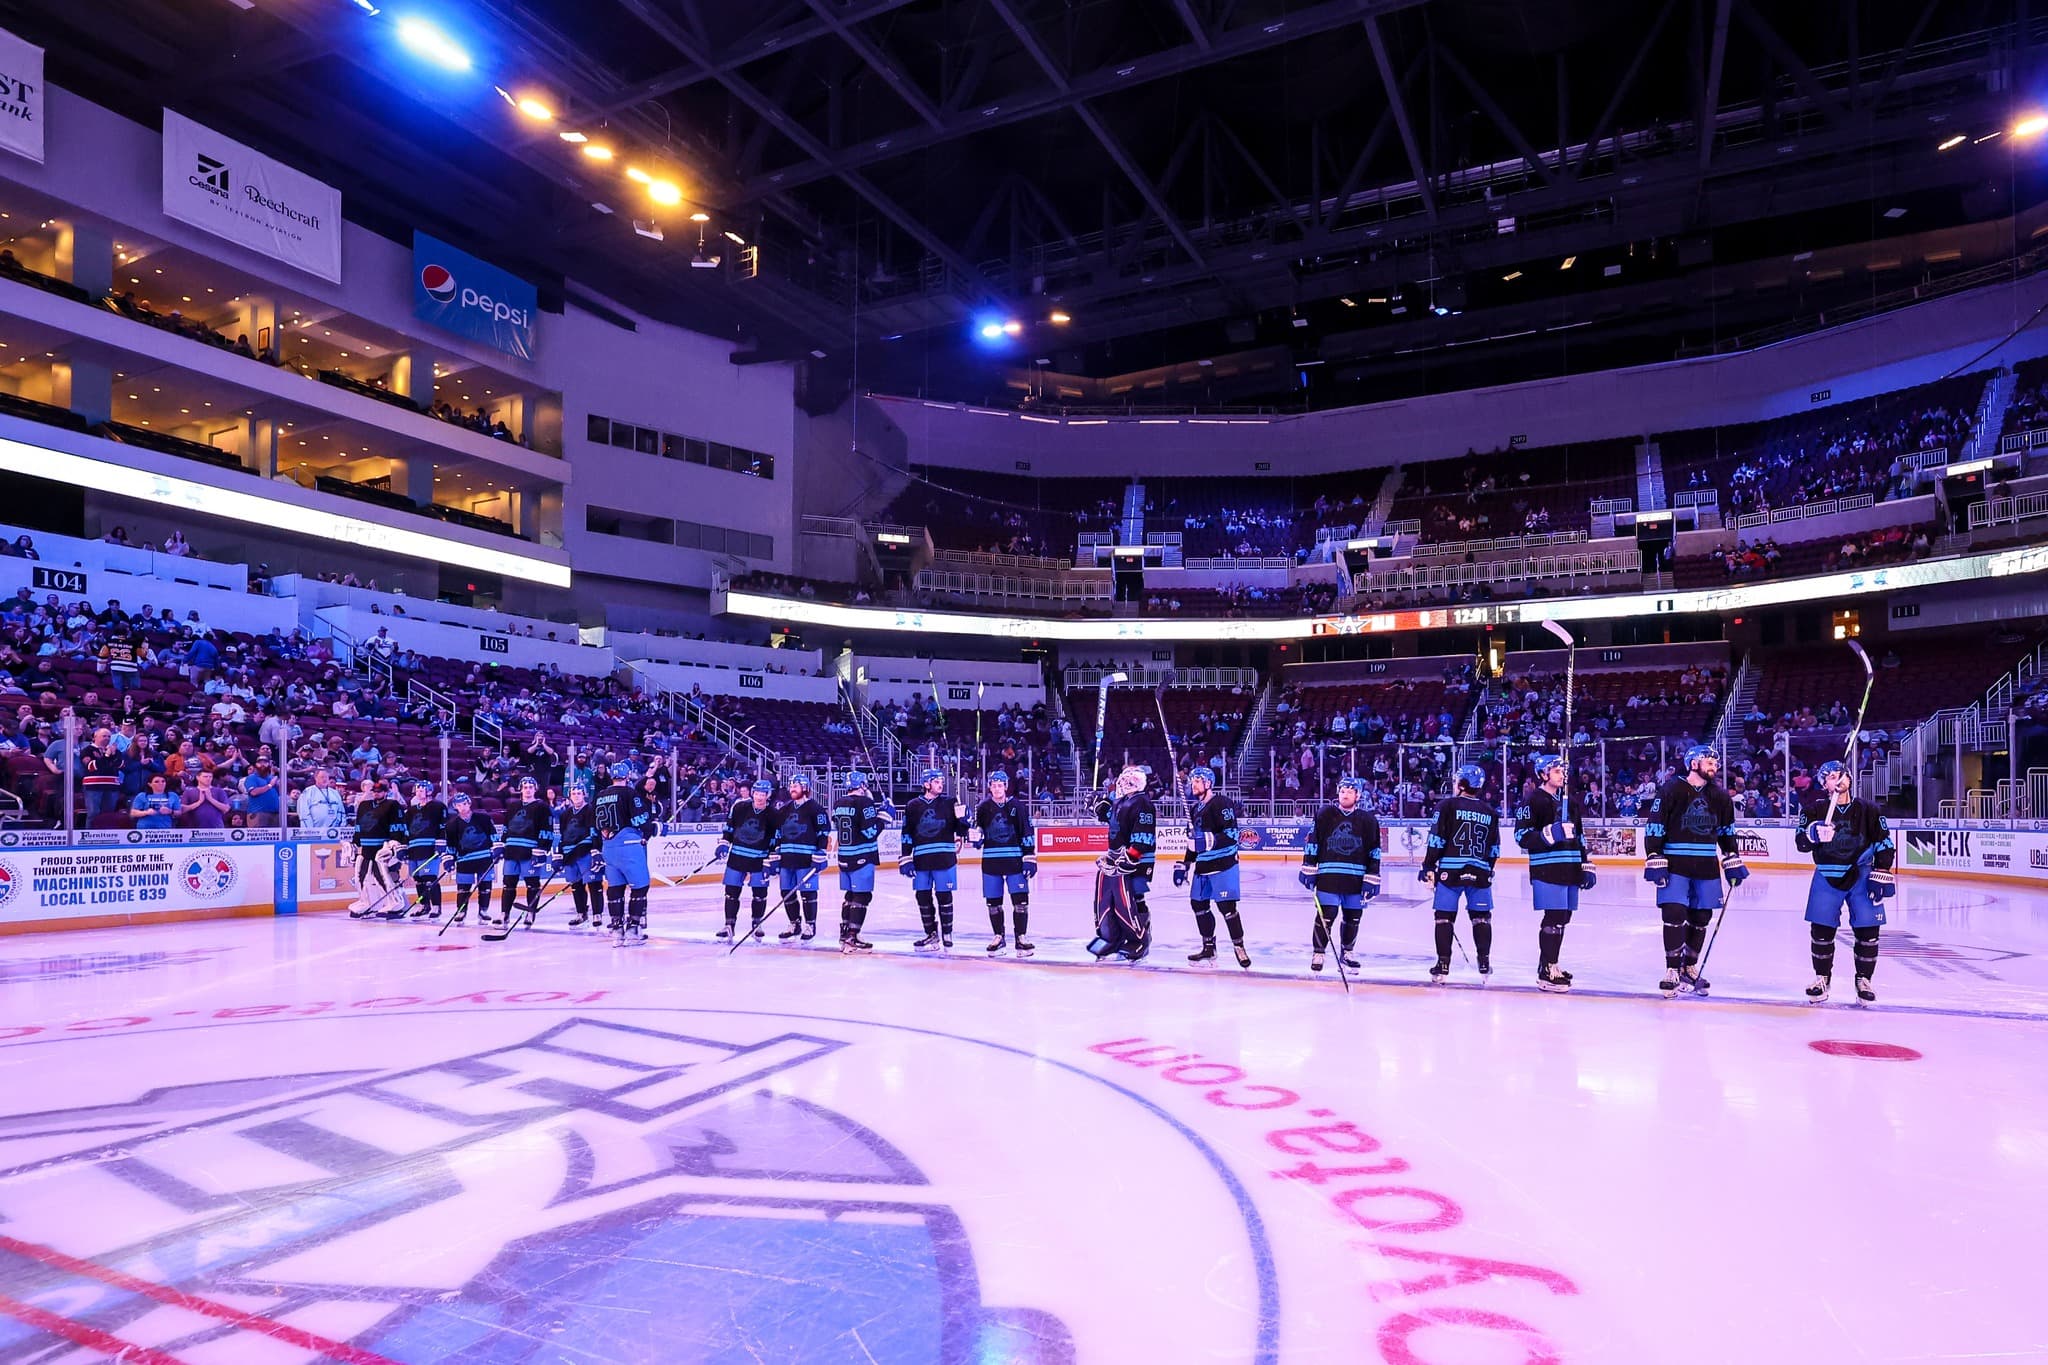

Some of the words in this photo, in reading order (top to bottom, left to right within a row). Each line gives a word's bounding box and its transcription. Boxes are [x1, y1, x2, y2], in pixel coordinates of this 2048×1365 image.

[188, 175, 229, 200] Cessna
[244, 185, 320, 230] Beechcraft
[461, 288, 528, 329] pepsi
[40, 569, 82, 591] 104
[484, 637, 505, 652] 105
[1603, 651, 1621, 661] 110
[1370, 664, 1386, 673] 109
[743, 675, 761, 687] 106
[952, 689, 969, 699] 107
[595, 803, 620, 832] 21
[1456, 810, 1492, 825] PRESTON
[1516, 805, 1531, 821] 44
[1452, 821, 1489, 860] 43
[1744, 839, 1768, 851] PEAKS
[1937, 831, 1971, 858] ECK
[40, 856, 73, 866] PROUD
[76, 855, 134, 865] SUPPORTERS
[136, 854, 147, 863] OF
[149, 854, 165, 862] THE
[1937, 858, 1971, 868] SERVICES
[33, 866, 77, 876] THUNDER
[80, 865, 98, 875] AND
[101, 864, 118, 874] THE
[120, 863, 174, 873] COMMUNITY
[33, 875, 124, 892] MACHINISTS
[128, 873, 169, 887] UNION
[40, 892, 86, 907] LOCAL
[91, 889, 135, 904] LODGE
[139, 888, 167, 901] 839
